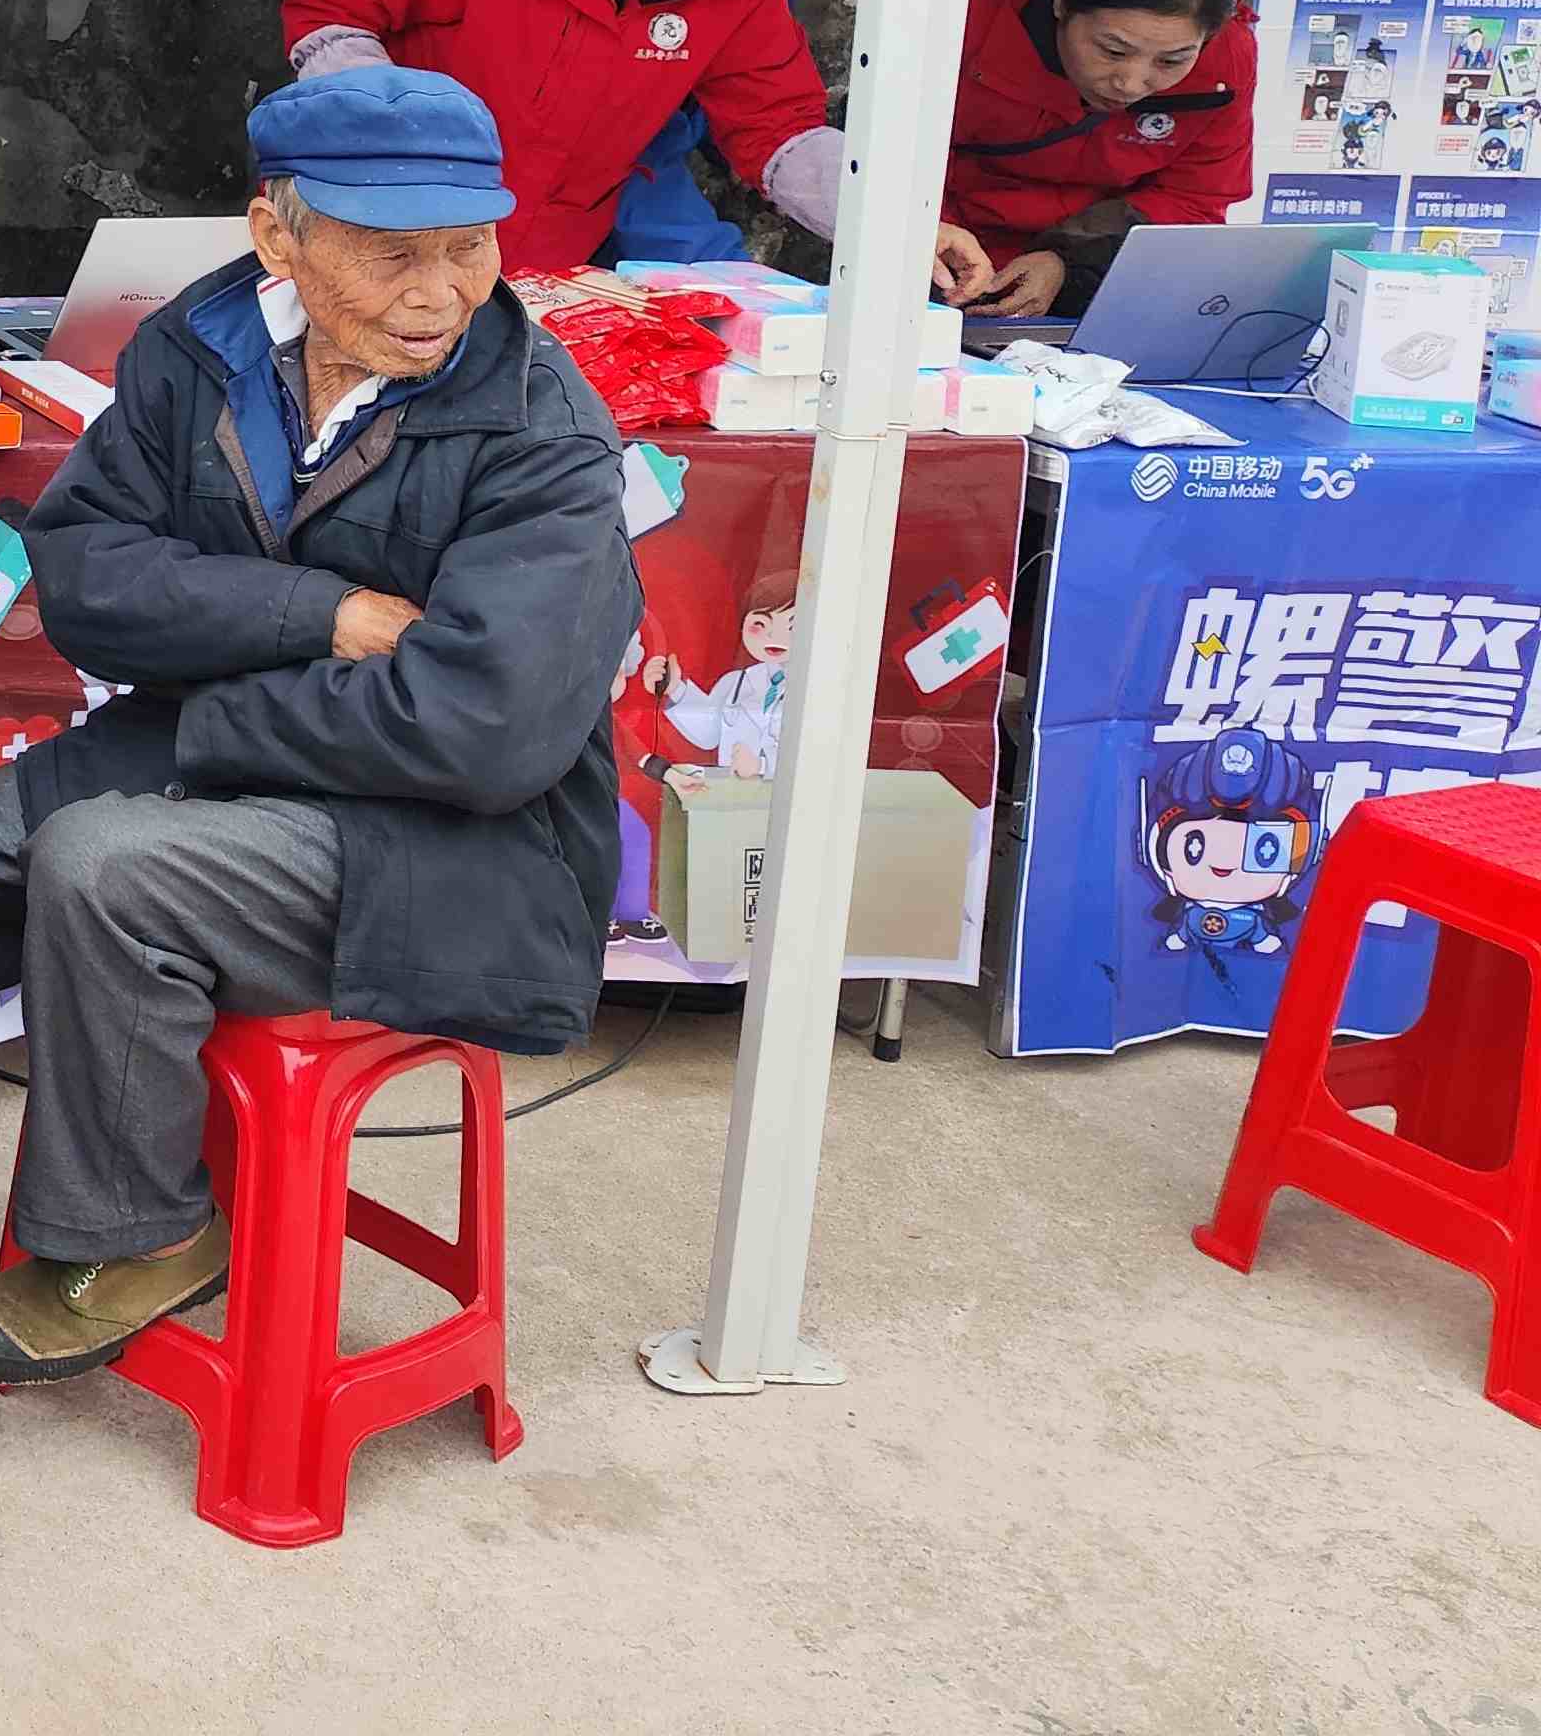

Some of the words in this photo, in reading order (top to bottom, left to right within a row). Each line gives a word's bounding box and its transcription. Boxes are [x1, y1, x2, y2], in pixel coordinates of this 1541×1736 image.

[1186, 454, 1282, 483] 中国移动
[1182, 481, 1226, 499] China
[1228, 483, 1277, 500] Mobile
